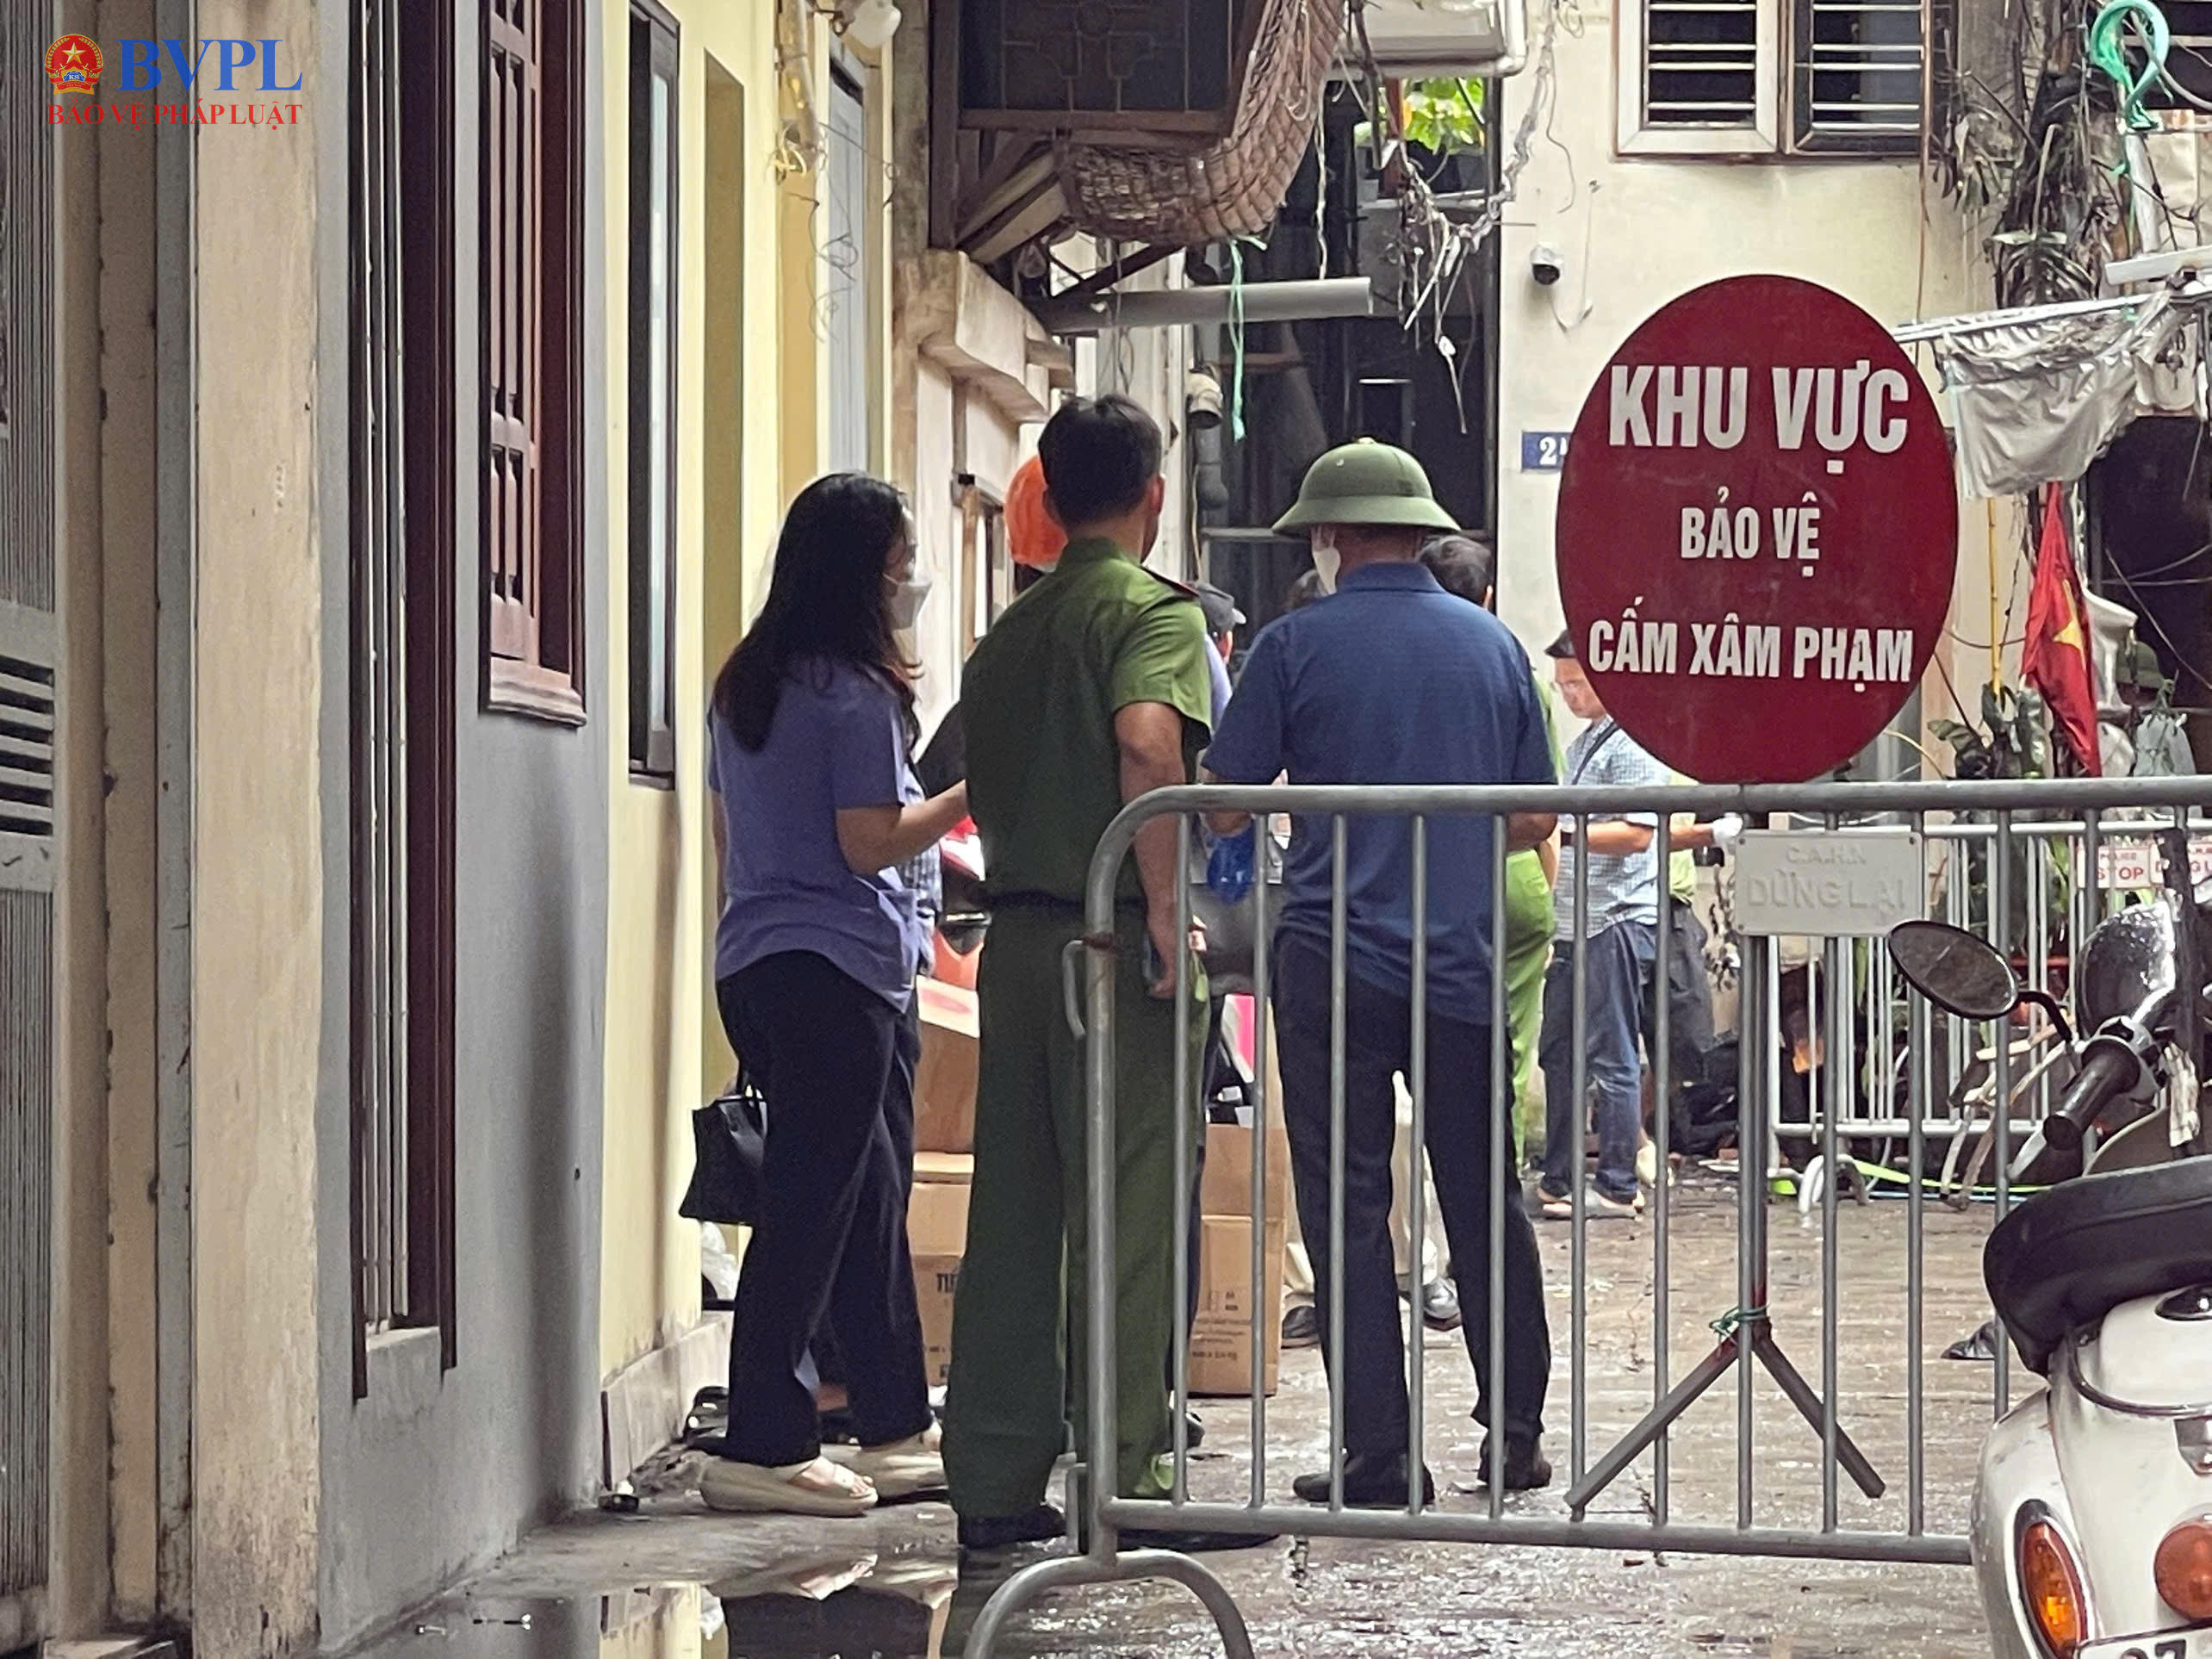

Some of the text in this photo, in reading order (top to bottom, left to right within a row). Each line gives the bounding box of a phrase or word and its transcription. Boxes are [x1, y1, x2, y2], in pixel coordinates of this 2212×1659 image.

[1608, 360, 1909, 474] KHU VỰC
[1681, 486, 1820, 577] BẢO VỆ
[1588, 596, 1913, 692] CẤM XÂM PHẠM
[2097, 866, 2144, 880] SOP
